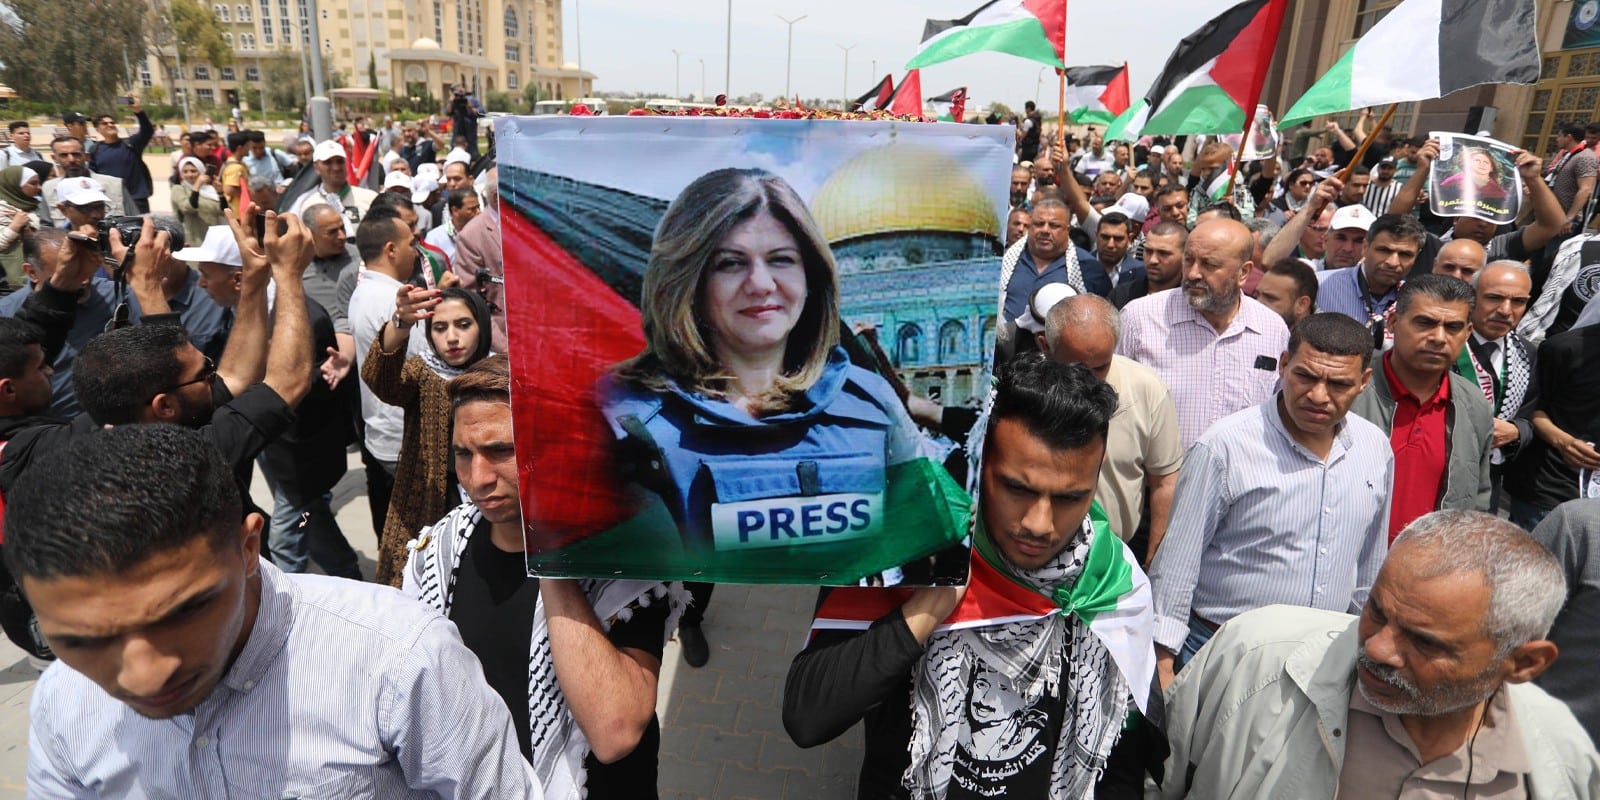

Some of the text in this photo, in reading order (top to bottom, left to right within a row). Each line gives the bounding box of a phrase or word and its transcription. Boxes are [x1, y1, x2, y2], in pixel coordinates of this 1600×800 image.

[737, 499, 871, 543] PRESS
[1020, 740, 1047, 766] كتلة
[981, 760, 1024, 781] الشهيد
[979, 785, 1007, 797] جامعة
